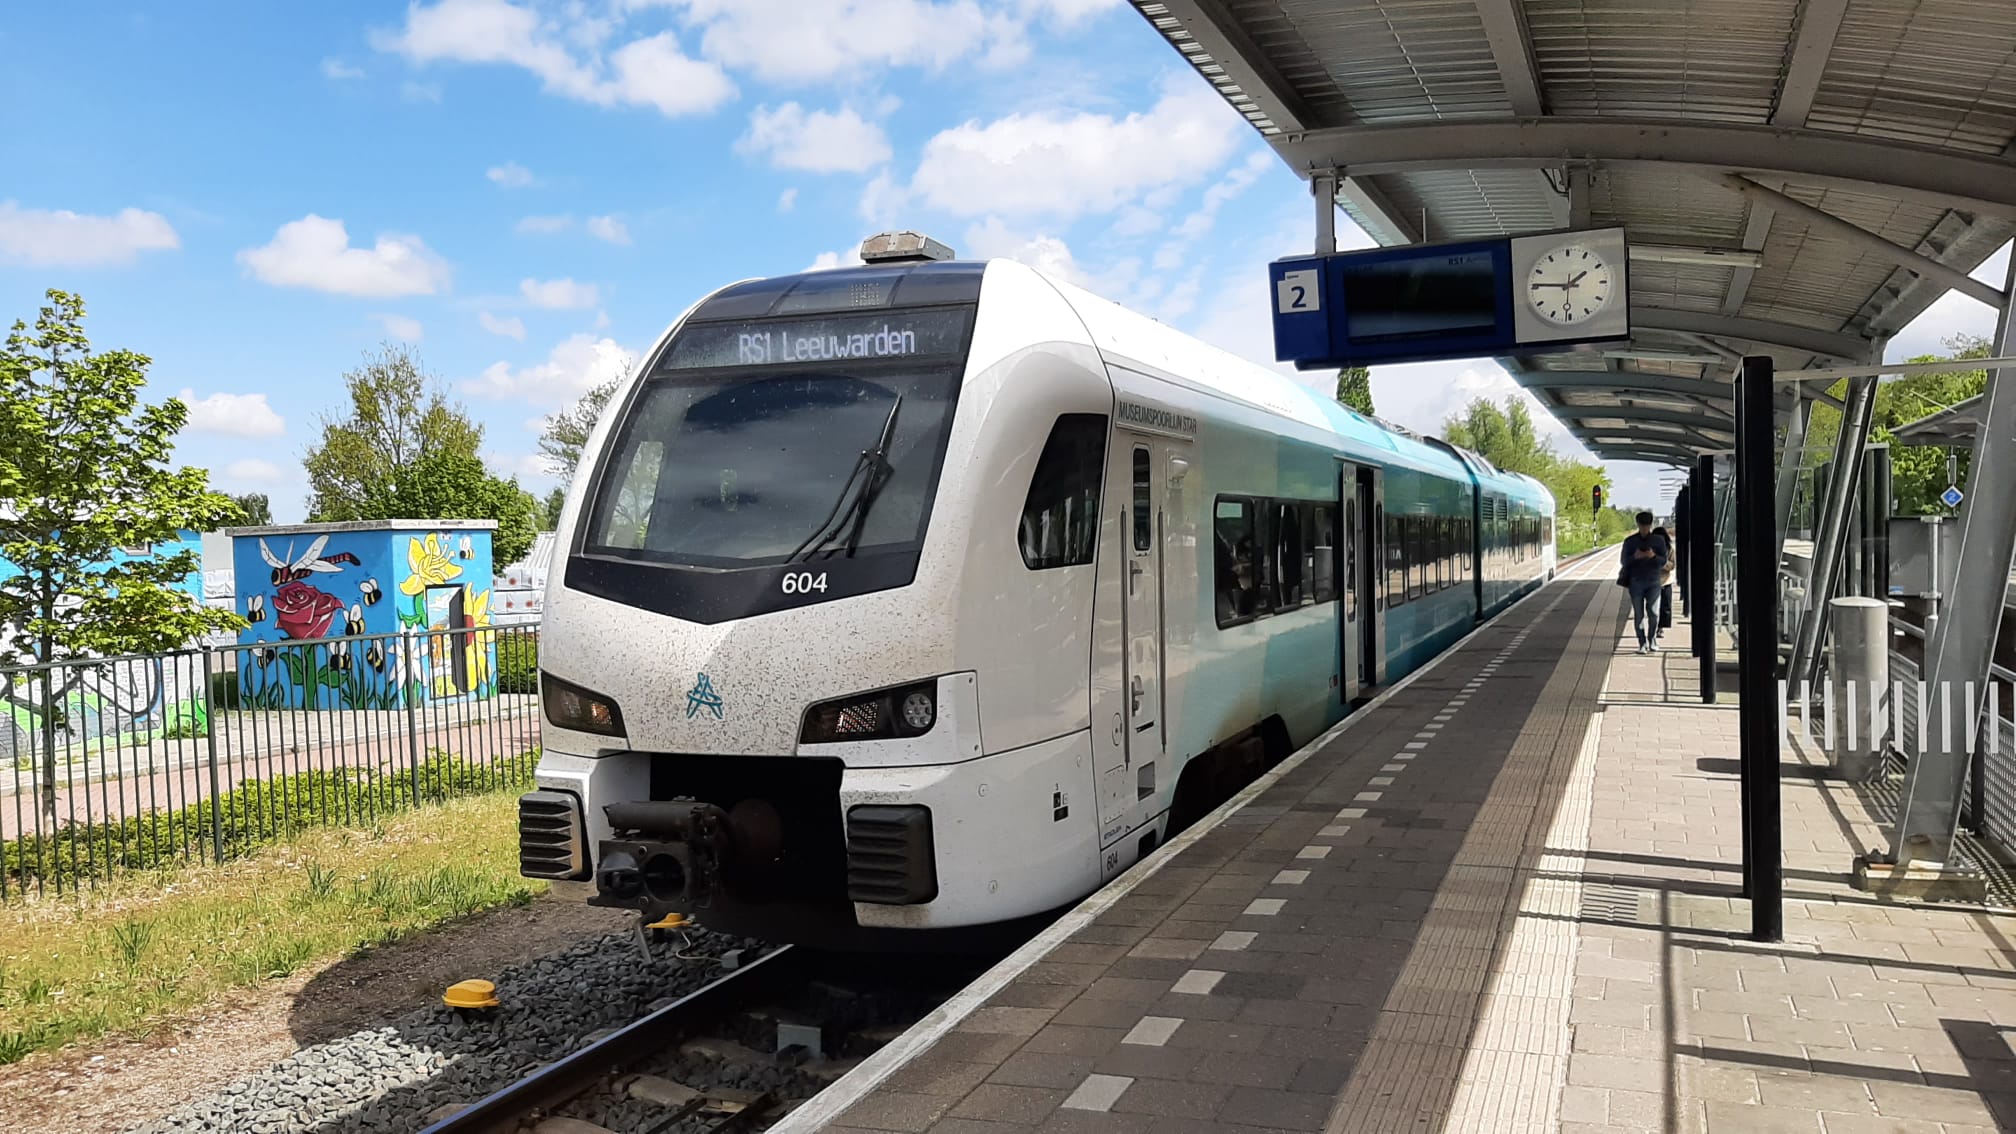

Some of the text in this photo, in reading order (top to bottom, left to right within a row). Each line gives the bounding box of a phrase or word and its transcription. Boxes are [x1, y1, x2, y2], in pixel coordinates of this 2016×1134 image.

[1291, 286, 1307, 309] 2
[739, 324, 915, 363] RS1 Leeuwarden
[1183, 416, 1197, 434] STAR
[782, 572, 828, 594] 604
[1106, 851, 1118, 872] 604
